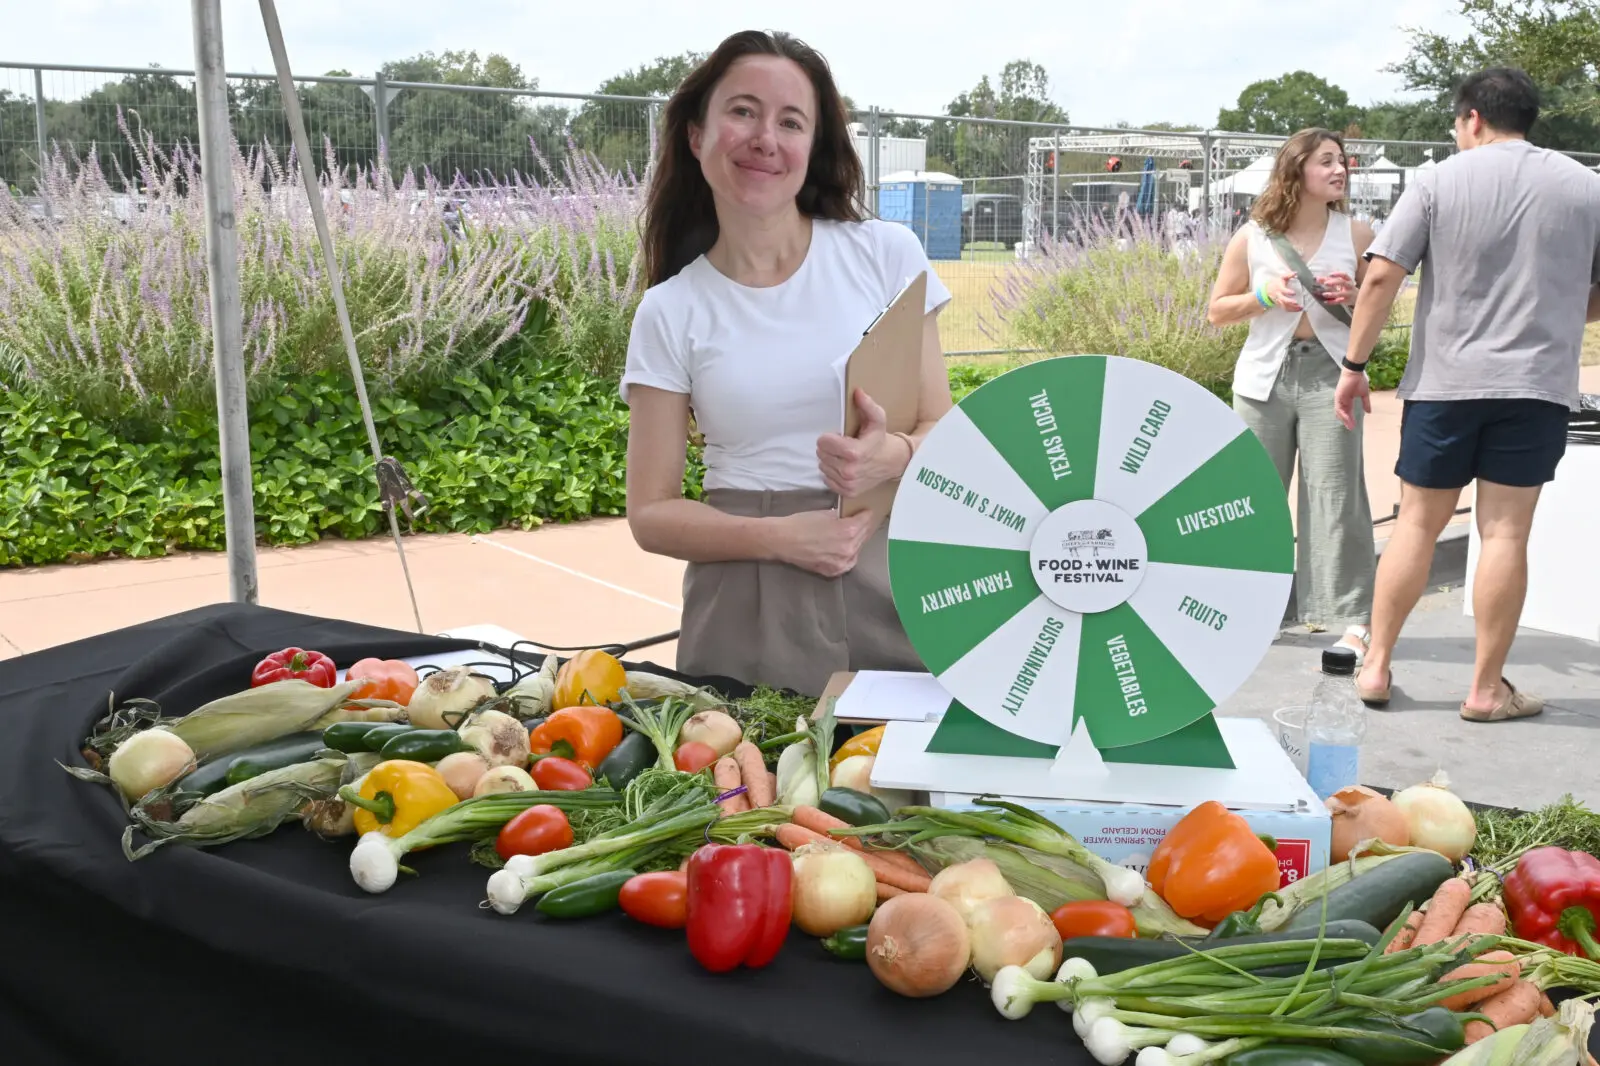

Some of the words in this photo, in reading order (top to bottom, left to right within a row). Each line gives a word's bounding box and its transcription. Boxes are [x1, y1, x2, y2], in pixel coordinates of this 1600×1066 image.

[1029, 389, 1057, 434] LOCAL
[1120, 431, 1151, 474] WILD
[1141, 400, 1171, 437] CARD
[1043, 436, 1072, 480] TEXAS
[916, 467, 963, 500] SEASON
[963, 490, 979, 508] IN
[980, 499, 1026, 532] WHAT'S
[1177, 496, 1255, 535] LIVESTOCK
[1039, 559, 1083, 571] FOOD
[1095, 558, 1140, 571] WINE
[1054, 572, 1124, 583] FESTIVAL
[921, 583, 972, 613] PANTRY
[976, 571, 1013, 597] FARM
[1178, 596, 1227, 630] FRUITS
[1002, 617, 1063, 716] SUSTAINABILITY
[1107, 635, 1147, 716] VEGETABLES
[1083, 836, 1112, 844] WATER
[1101, 827, 1139, 835] ICELAND
[1114, 836, 1145, 845] SPRING
